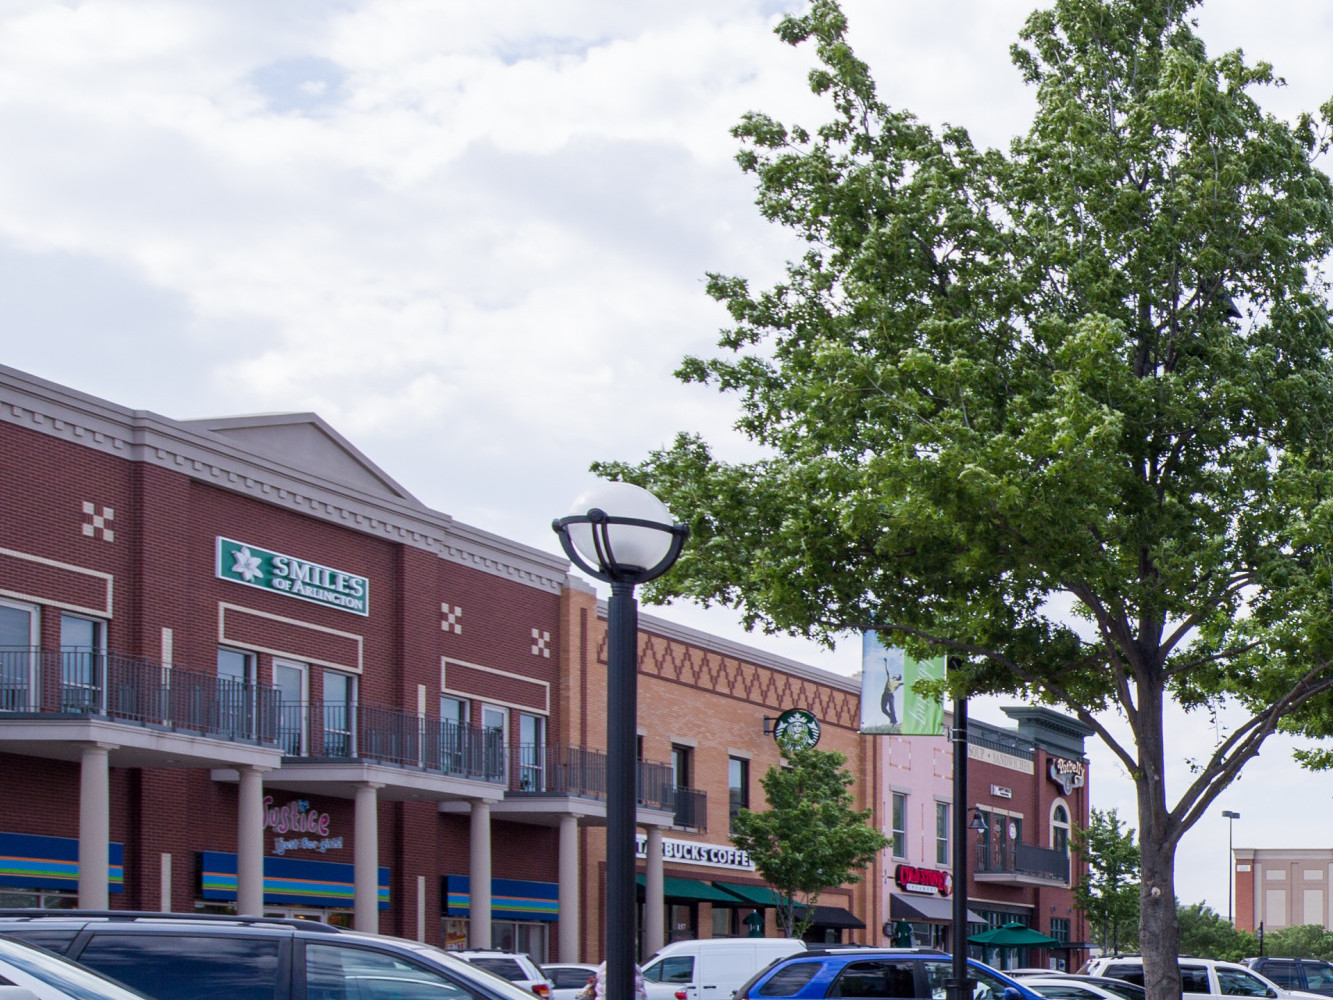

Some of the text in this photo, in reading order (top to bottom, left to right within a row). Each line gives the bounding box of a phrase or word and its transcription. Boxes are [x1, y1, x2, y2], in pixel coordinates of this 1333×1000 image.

[271, 556, 363, 597] SMILES
[271, 577, 363, 610] OF ARLINGTON
[636, 839, 708, 861] TBUCKS
